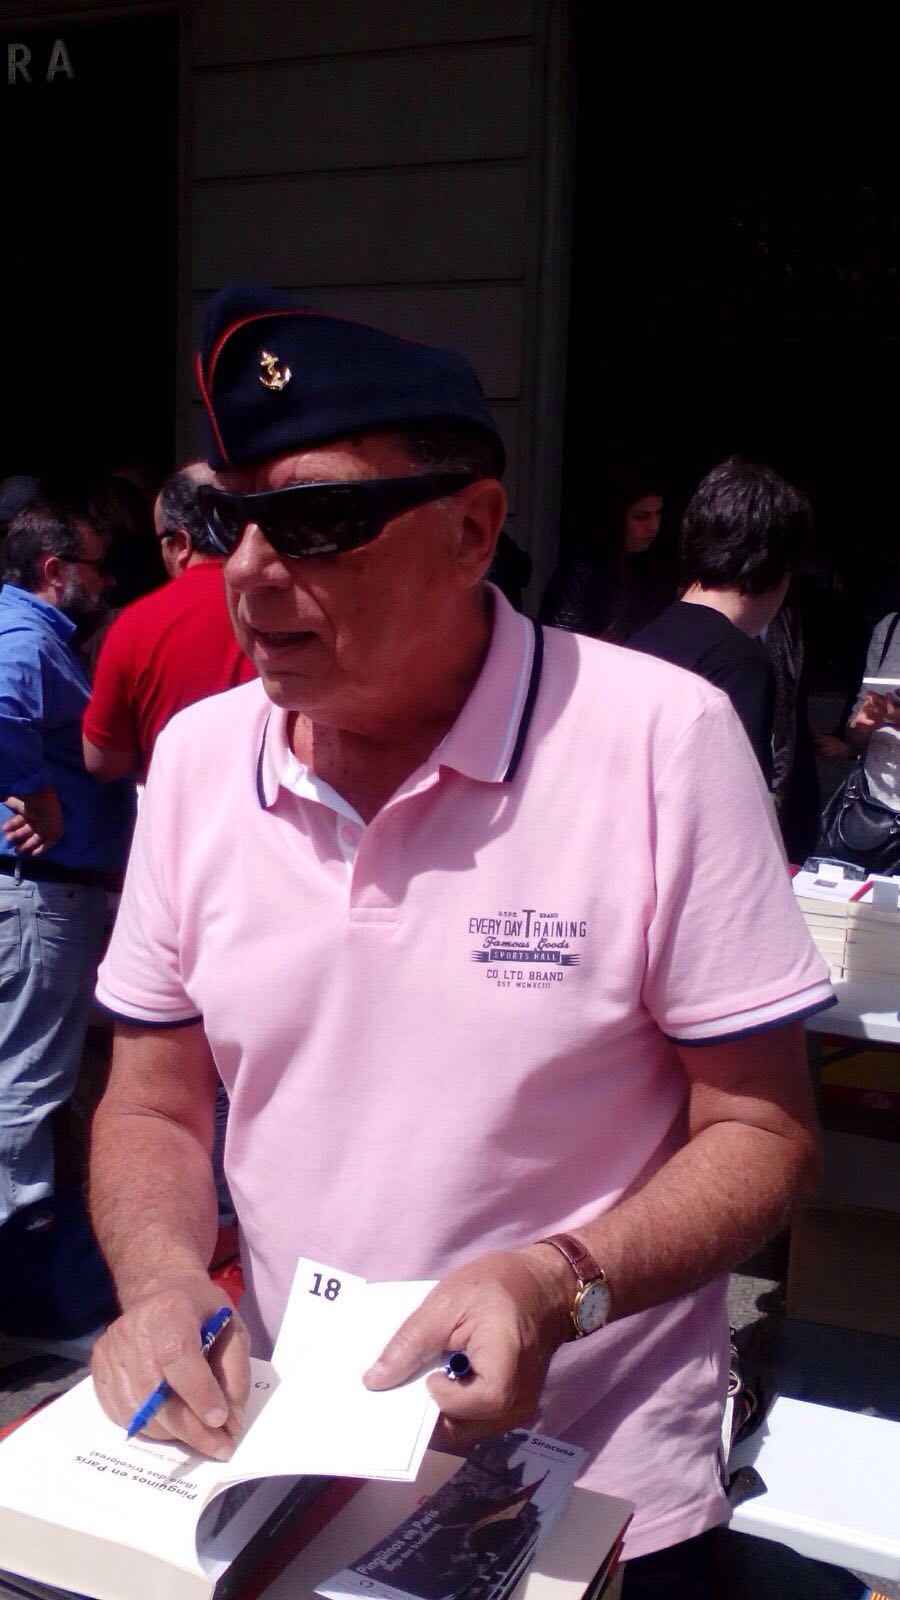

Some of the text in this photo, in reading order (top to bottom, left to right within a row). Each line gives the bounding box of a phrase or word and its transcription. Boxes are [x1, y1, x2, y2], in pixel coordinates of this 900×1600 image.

[469, 910, 587, 938] EVERY DAY TRAINING
[483, 936, 570, 952] Famous Goods
[494, 951, 556, 960] SPORTS HALL
[529, 971, 564, 981] BRAND
[309, 1273, 341, 1301] 18
[111, 1468, 128, 1478] en
[147, 1470, 167, 1480] dos
